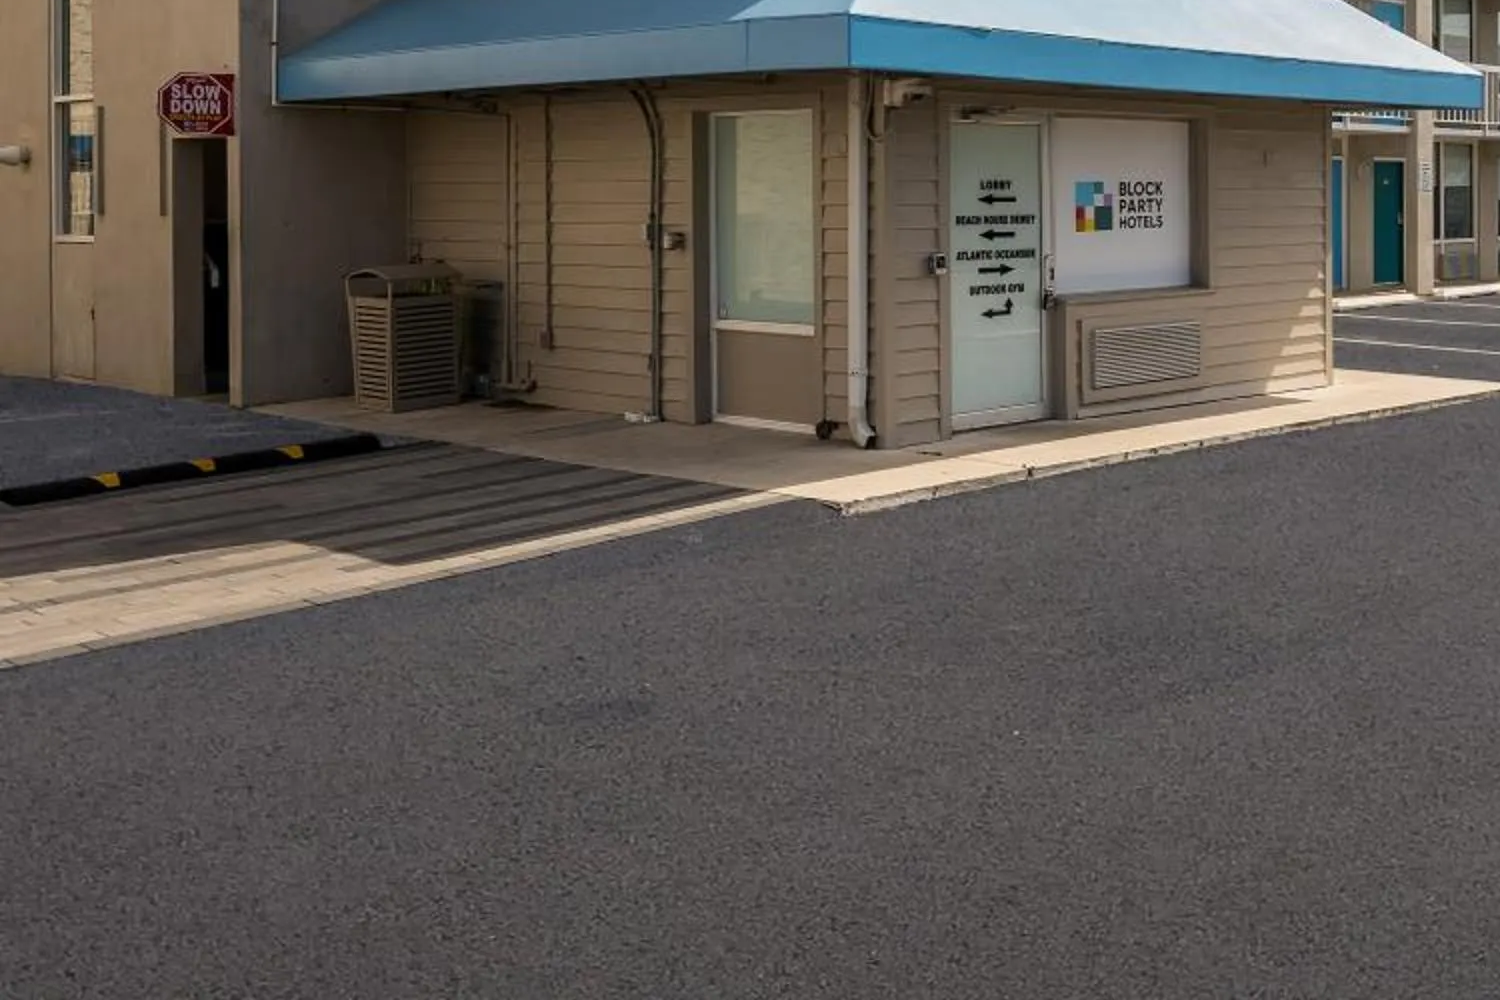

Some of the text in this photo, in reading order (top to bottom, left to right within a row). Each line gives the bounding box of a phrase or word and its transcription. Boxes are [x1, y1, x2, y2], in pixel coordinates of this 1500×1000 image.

[171, 83, 221, 100] SLOW
[171, 99, 221, 115] DOWN
[979, 180, 1011, 190] LOBBY
[1119, 181, 1163, 196] BLOCK
[1119, 198, 1163, 213] PARTY
[1119, 215, 1164, 229] HOTELS
[956, 250, 993, 260] ATLANTIC
